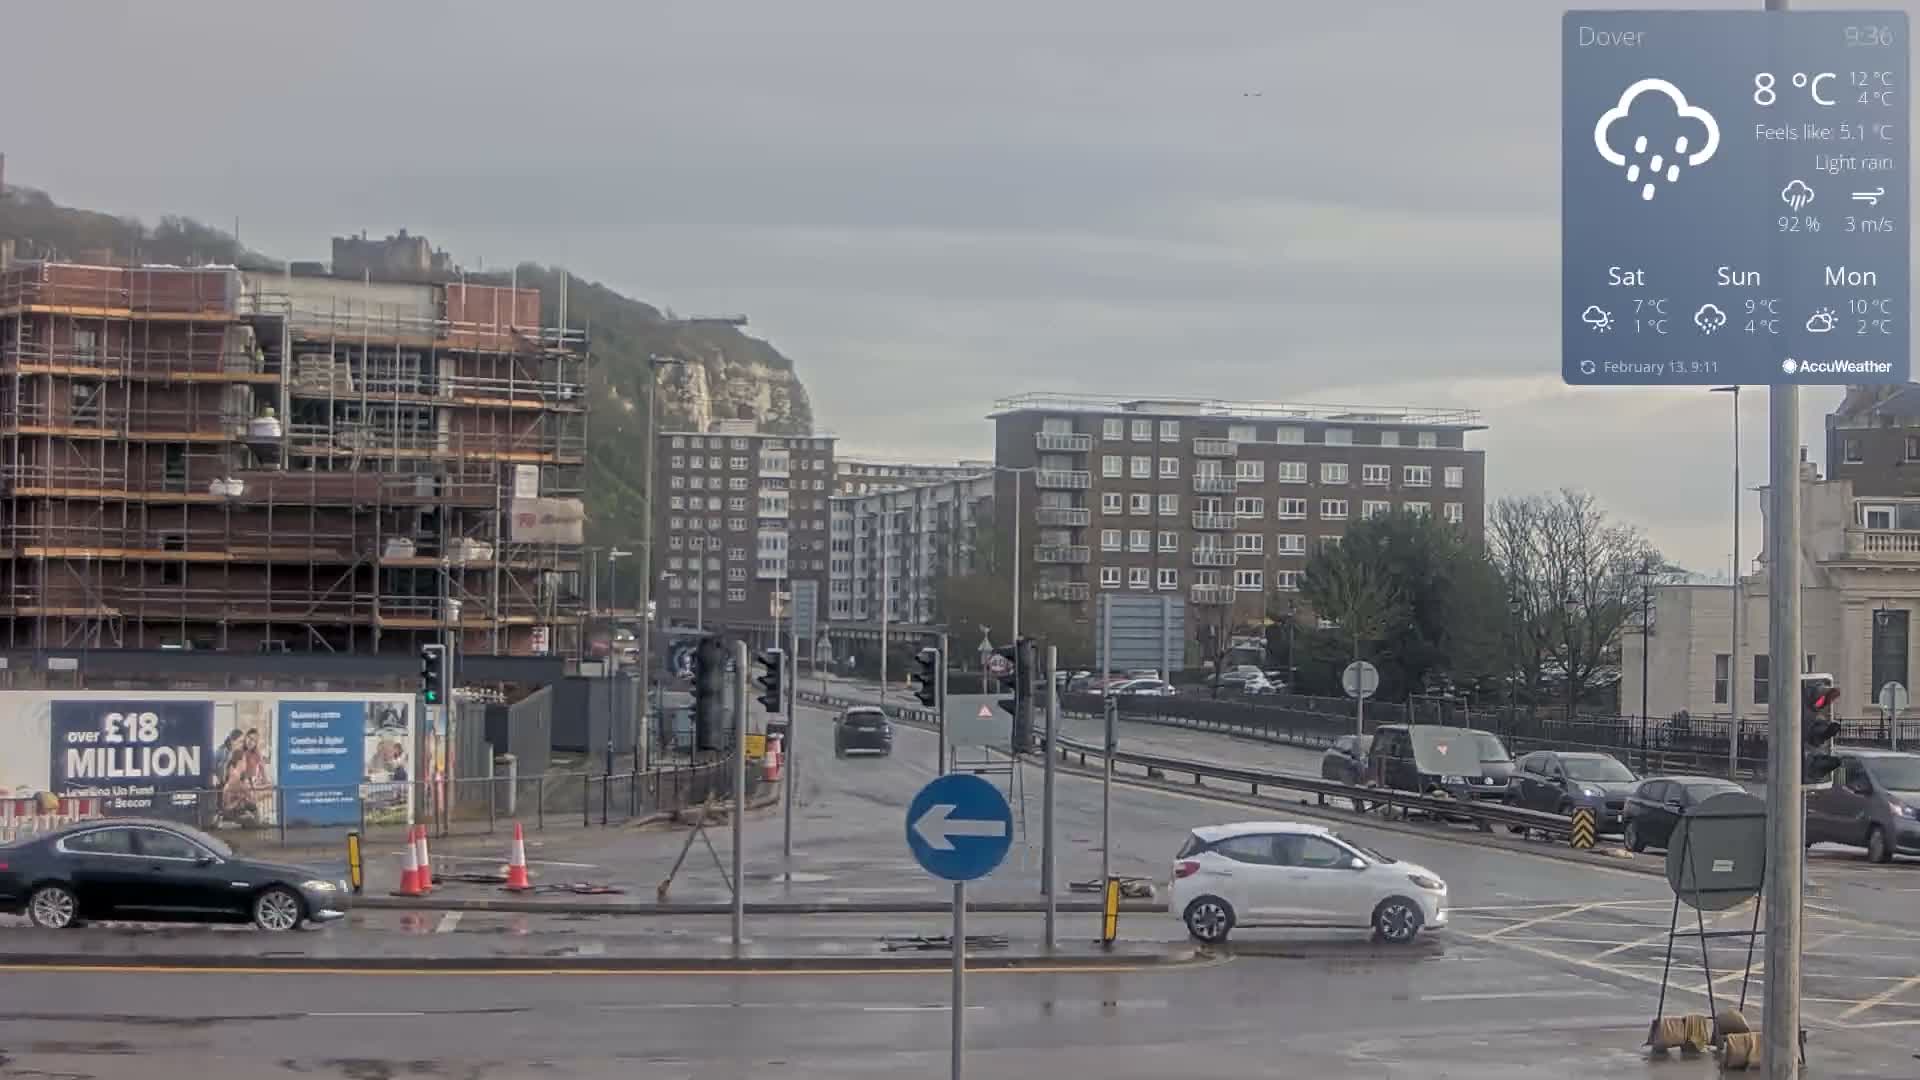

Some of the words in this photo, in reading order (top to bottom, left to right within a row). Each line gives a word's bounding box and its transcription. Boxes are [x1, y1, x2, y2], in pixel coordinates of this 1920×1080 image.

[67, 731, 100, 742] over
[104, 712, 159, 743] £18
[67, 746, 201, 778] MILLION
[114, 799, 152, 809] Beacon
